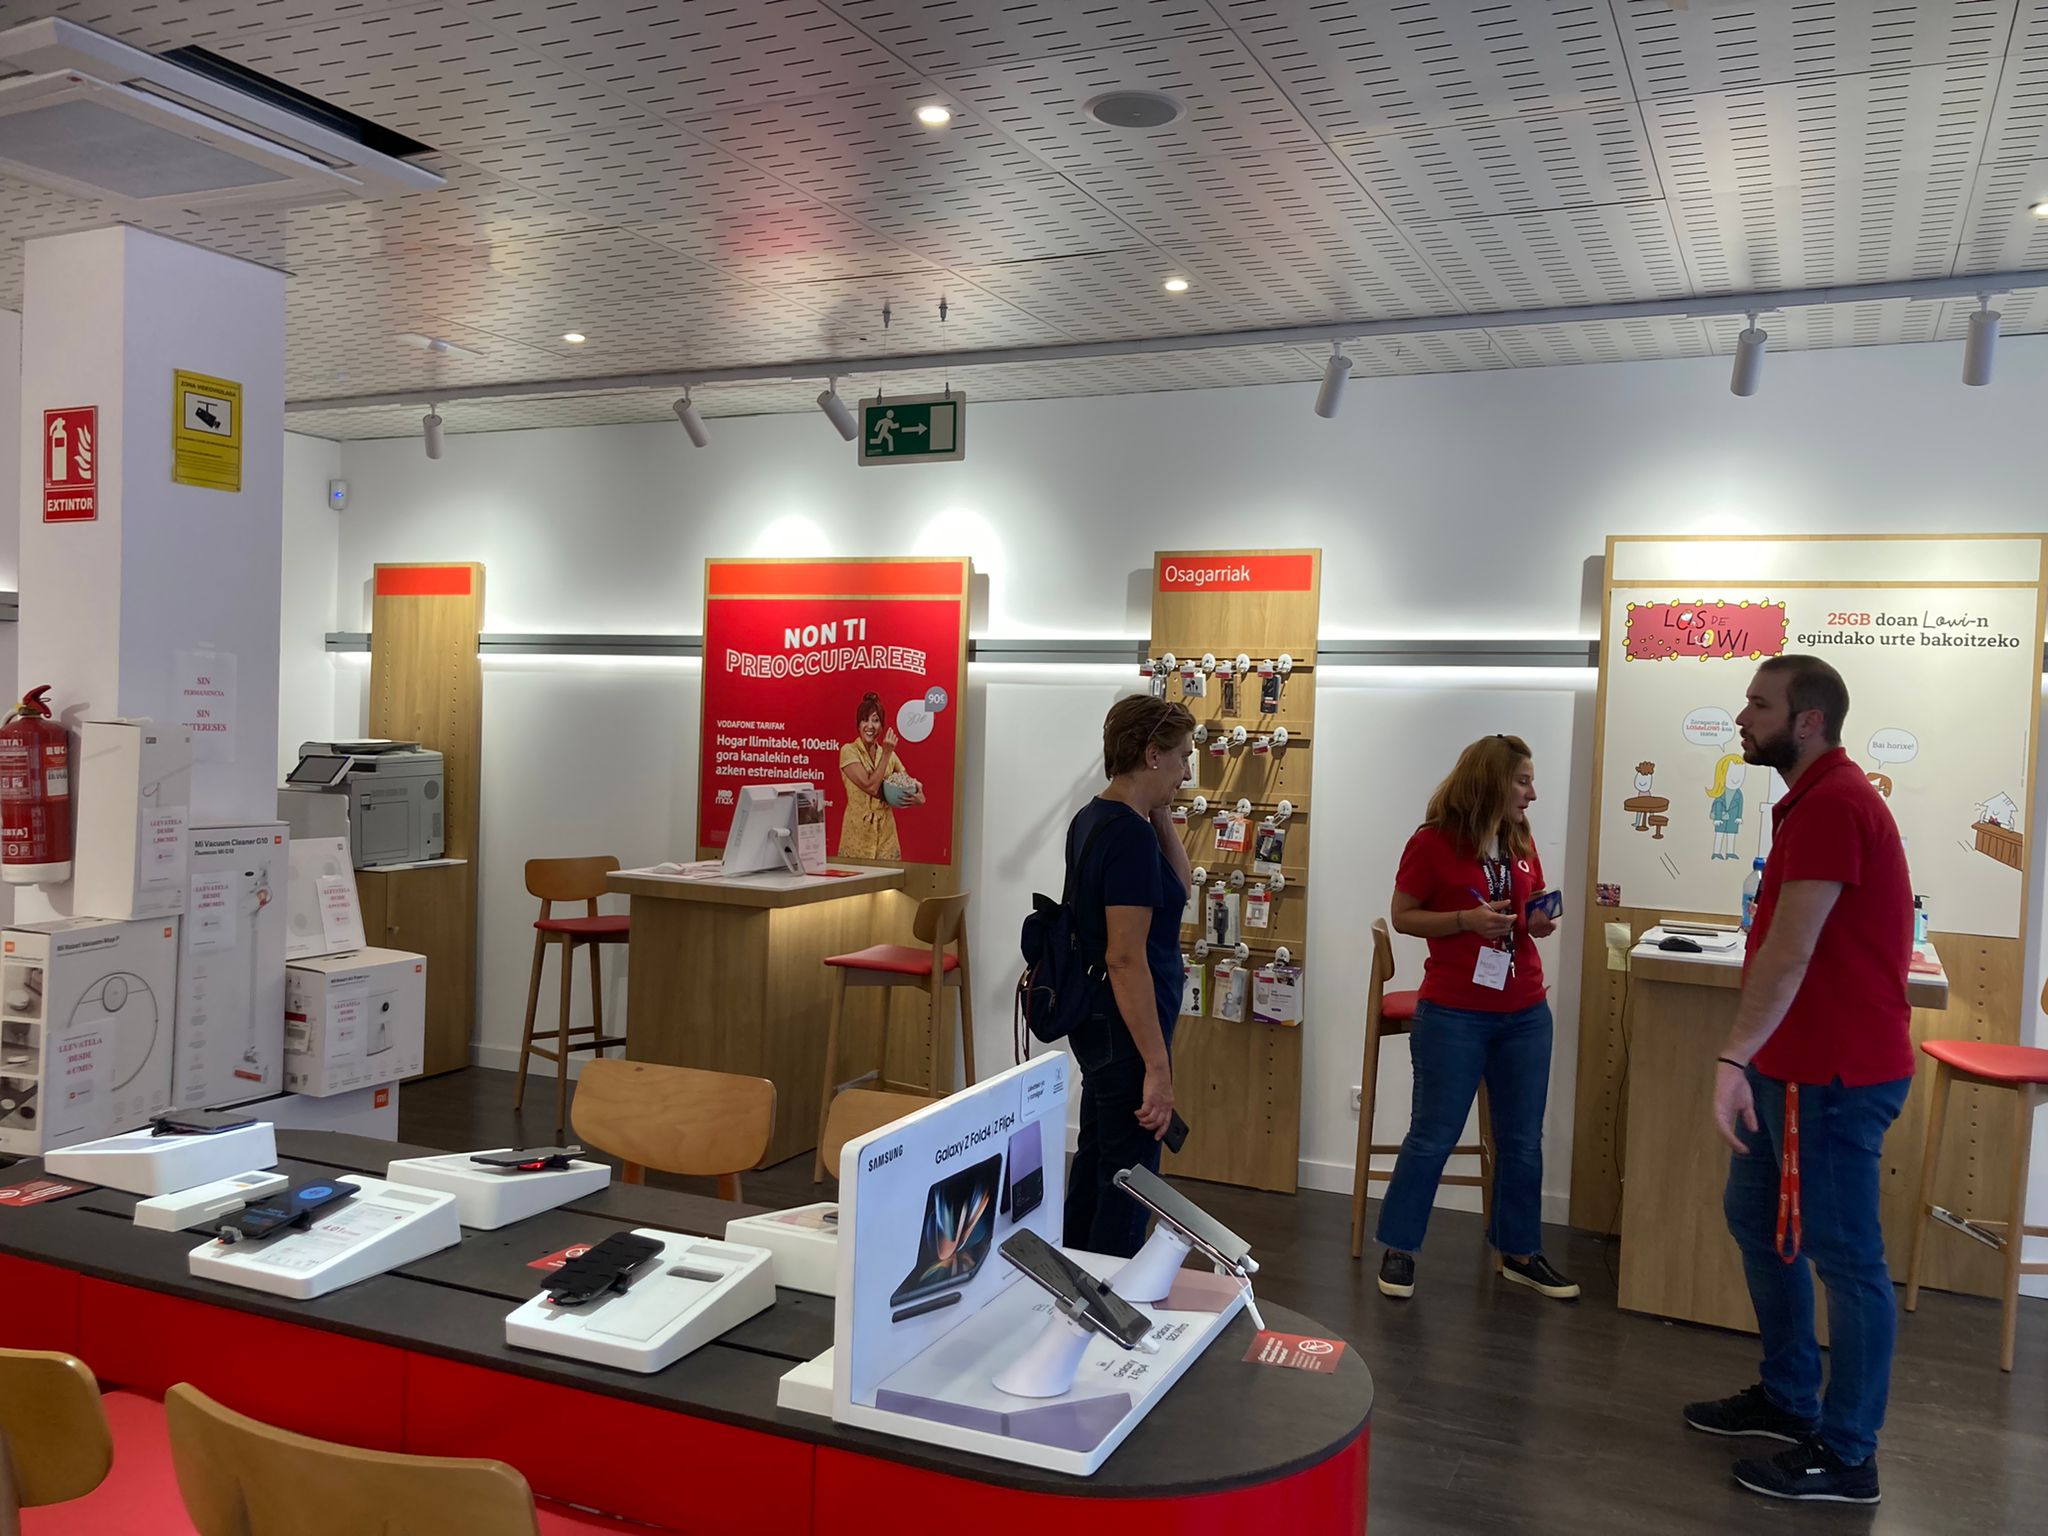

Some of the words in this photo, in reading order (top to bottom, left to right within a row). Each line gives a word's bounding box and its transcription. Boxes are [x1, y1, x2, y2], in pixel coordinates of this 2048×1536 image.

[48, 497, 93, 511] EXTINTOR
[1165, 565, 1250, 586] Osagarriak
[1711, 615, 1729, 626] DE
[1827, 612, 1871, 626] 25GB
[1875, 613, 1918, 627] doan
[785, 621, 837, 649] NON
[843, 618, 866, 641] TI
[1797, 631, 1875, 647] egindako
[1880, 634, 1916, 646] urte
[1920, 633, 2020, 648] bakoitzeko
[197, 677, 210, 685] SIN
[196, 709, 210, 718] SIN
[182, 722, 227, 731] TERESES
[717, 720, 755, 729] VODAFONE
[756, 721, 785, 730] TARIFAK
[716, 734, 747, 749] Hogar
[749, 735, 800, 750] Ilimitable,
[801, 738, 839, 751] 100etik
[1872, 741, 1885, 749] Bai
[716, 751, 738, 763] gora
[740, 750, 790, 763] kanalekin
[792, 754, 809, 764] eta
[715, 765, 746, 776] azken
[747, 766, 824, 780] estreinaldiekin
[715, 797, 734, 805] max
[231, 838, 256, 846] Cleaner
[935, 1140, 964, 1164] Galaxy
[964, 1135, 969, 1149] Z
[969, 1124, 991, 1147] Fold4
[998, 1112, 1015, 1132] Flip4
[868, 1144, 904, 1172] SAMSUNG
